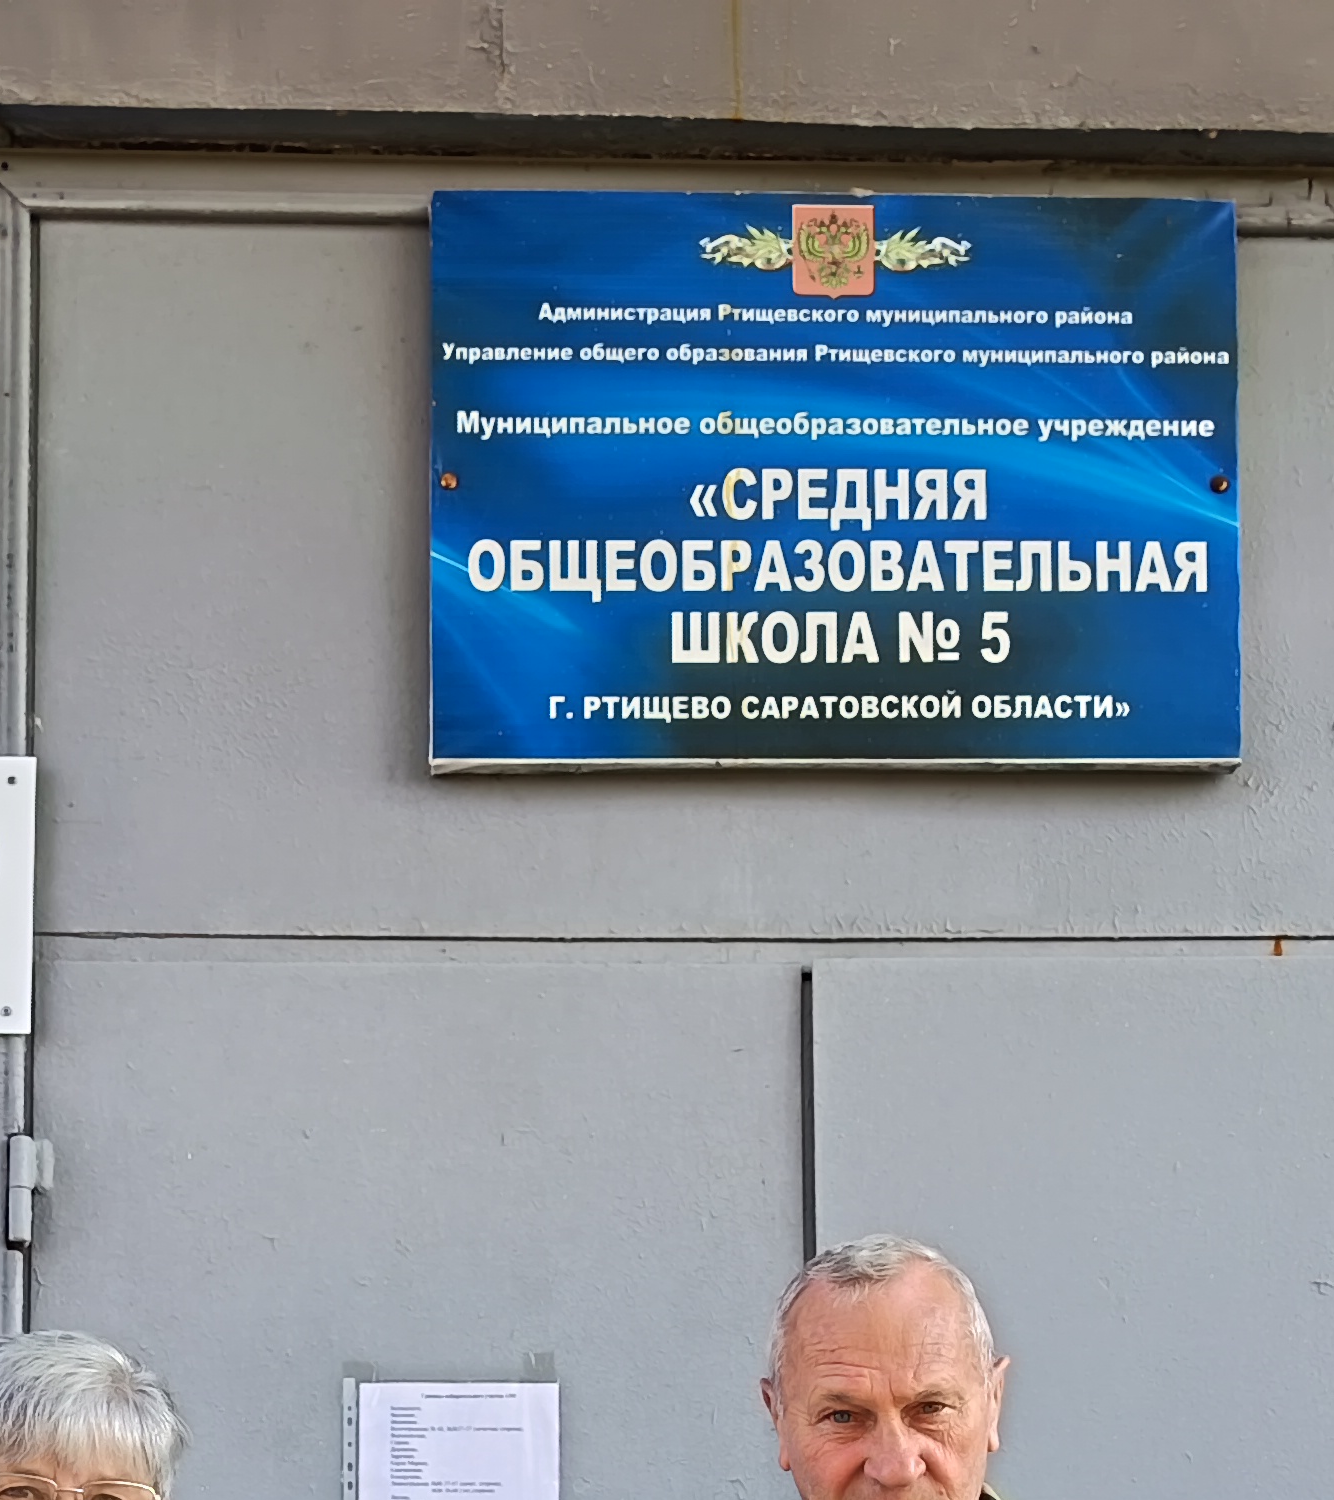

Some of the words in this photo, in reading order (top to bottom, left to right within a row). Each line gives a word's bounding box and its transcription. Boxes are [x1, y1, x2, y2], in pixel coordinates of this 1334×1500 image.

[538, 302, 712, 325] Администрация
[718, 303, 860, 324] Ртищевского
[865, 309, 1049, 328] муниципального
[1054, 310, 1133, 328] района
[442, 342, 574, 365] Управление
[579, 342, 660, 363] общего
[666, 343, 808, 365] образования
[815, 344, 956, 365] Ртищевского
[962, 349, 1145, 368] муниципального
[1150, 350, 1230, 369] района
[456, 410, 691, 441] Муниципальное
[699, 410, 1029, 441] общеобразовательное
[1037, 419, 1215, 442] учреждение
[689, 467, 987, 532] «СРЕДНЯЯ
[467, 538, 1208, 603] ОБЩЕОБРАЗОВАТЕЛЬНАЯ
[671, 610, 880, 664] ШКОЛА
[898, 610, 961, 664] №
[980, 611, 1011, 664] 5
[549, 695, 574, 720] Г.
[583, 695, 732, 724] РТИЩЕВО
[741, 689, 962, 720] САРАТОВСКОЙ
[971, 694, 1130, 719] ОБЛАСТИ»
